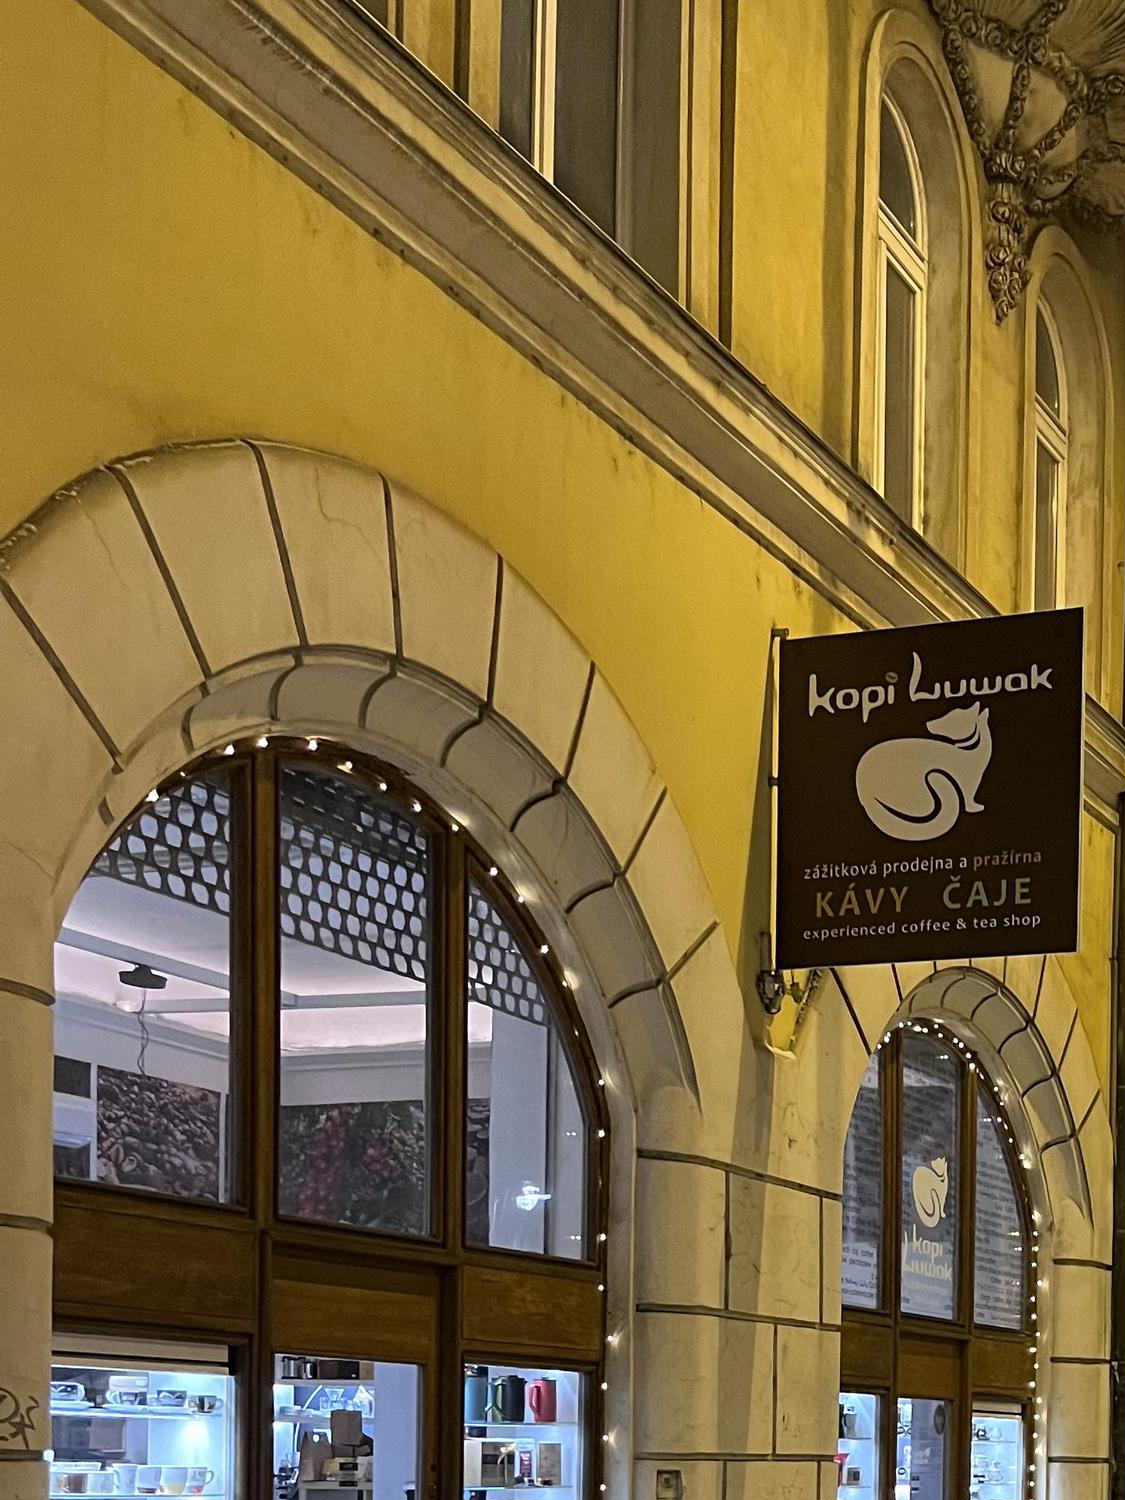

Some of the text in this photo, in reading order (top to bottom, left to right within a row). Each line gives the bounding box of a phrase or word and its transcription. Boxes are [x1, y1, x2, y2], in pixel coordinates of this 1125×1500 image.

[808, 671, 898, 723] kopi
[803, 849, 1042, 880] zážitková prodejna a pražírna
[815, 874, 1032, 918] KÁVY ČAJE
[803, 914, 1041, 941] experienced coffee & tea shop
[912, 1223, 943, 1264] kopi
